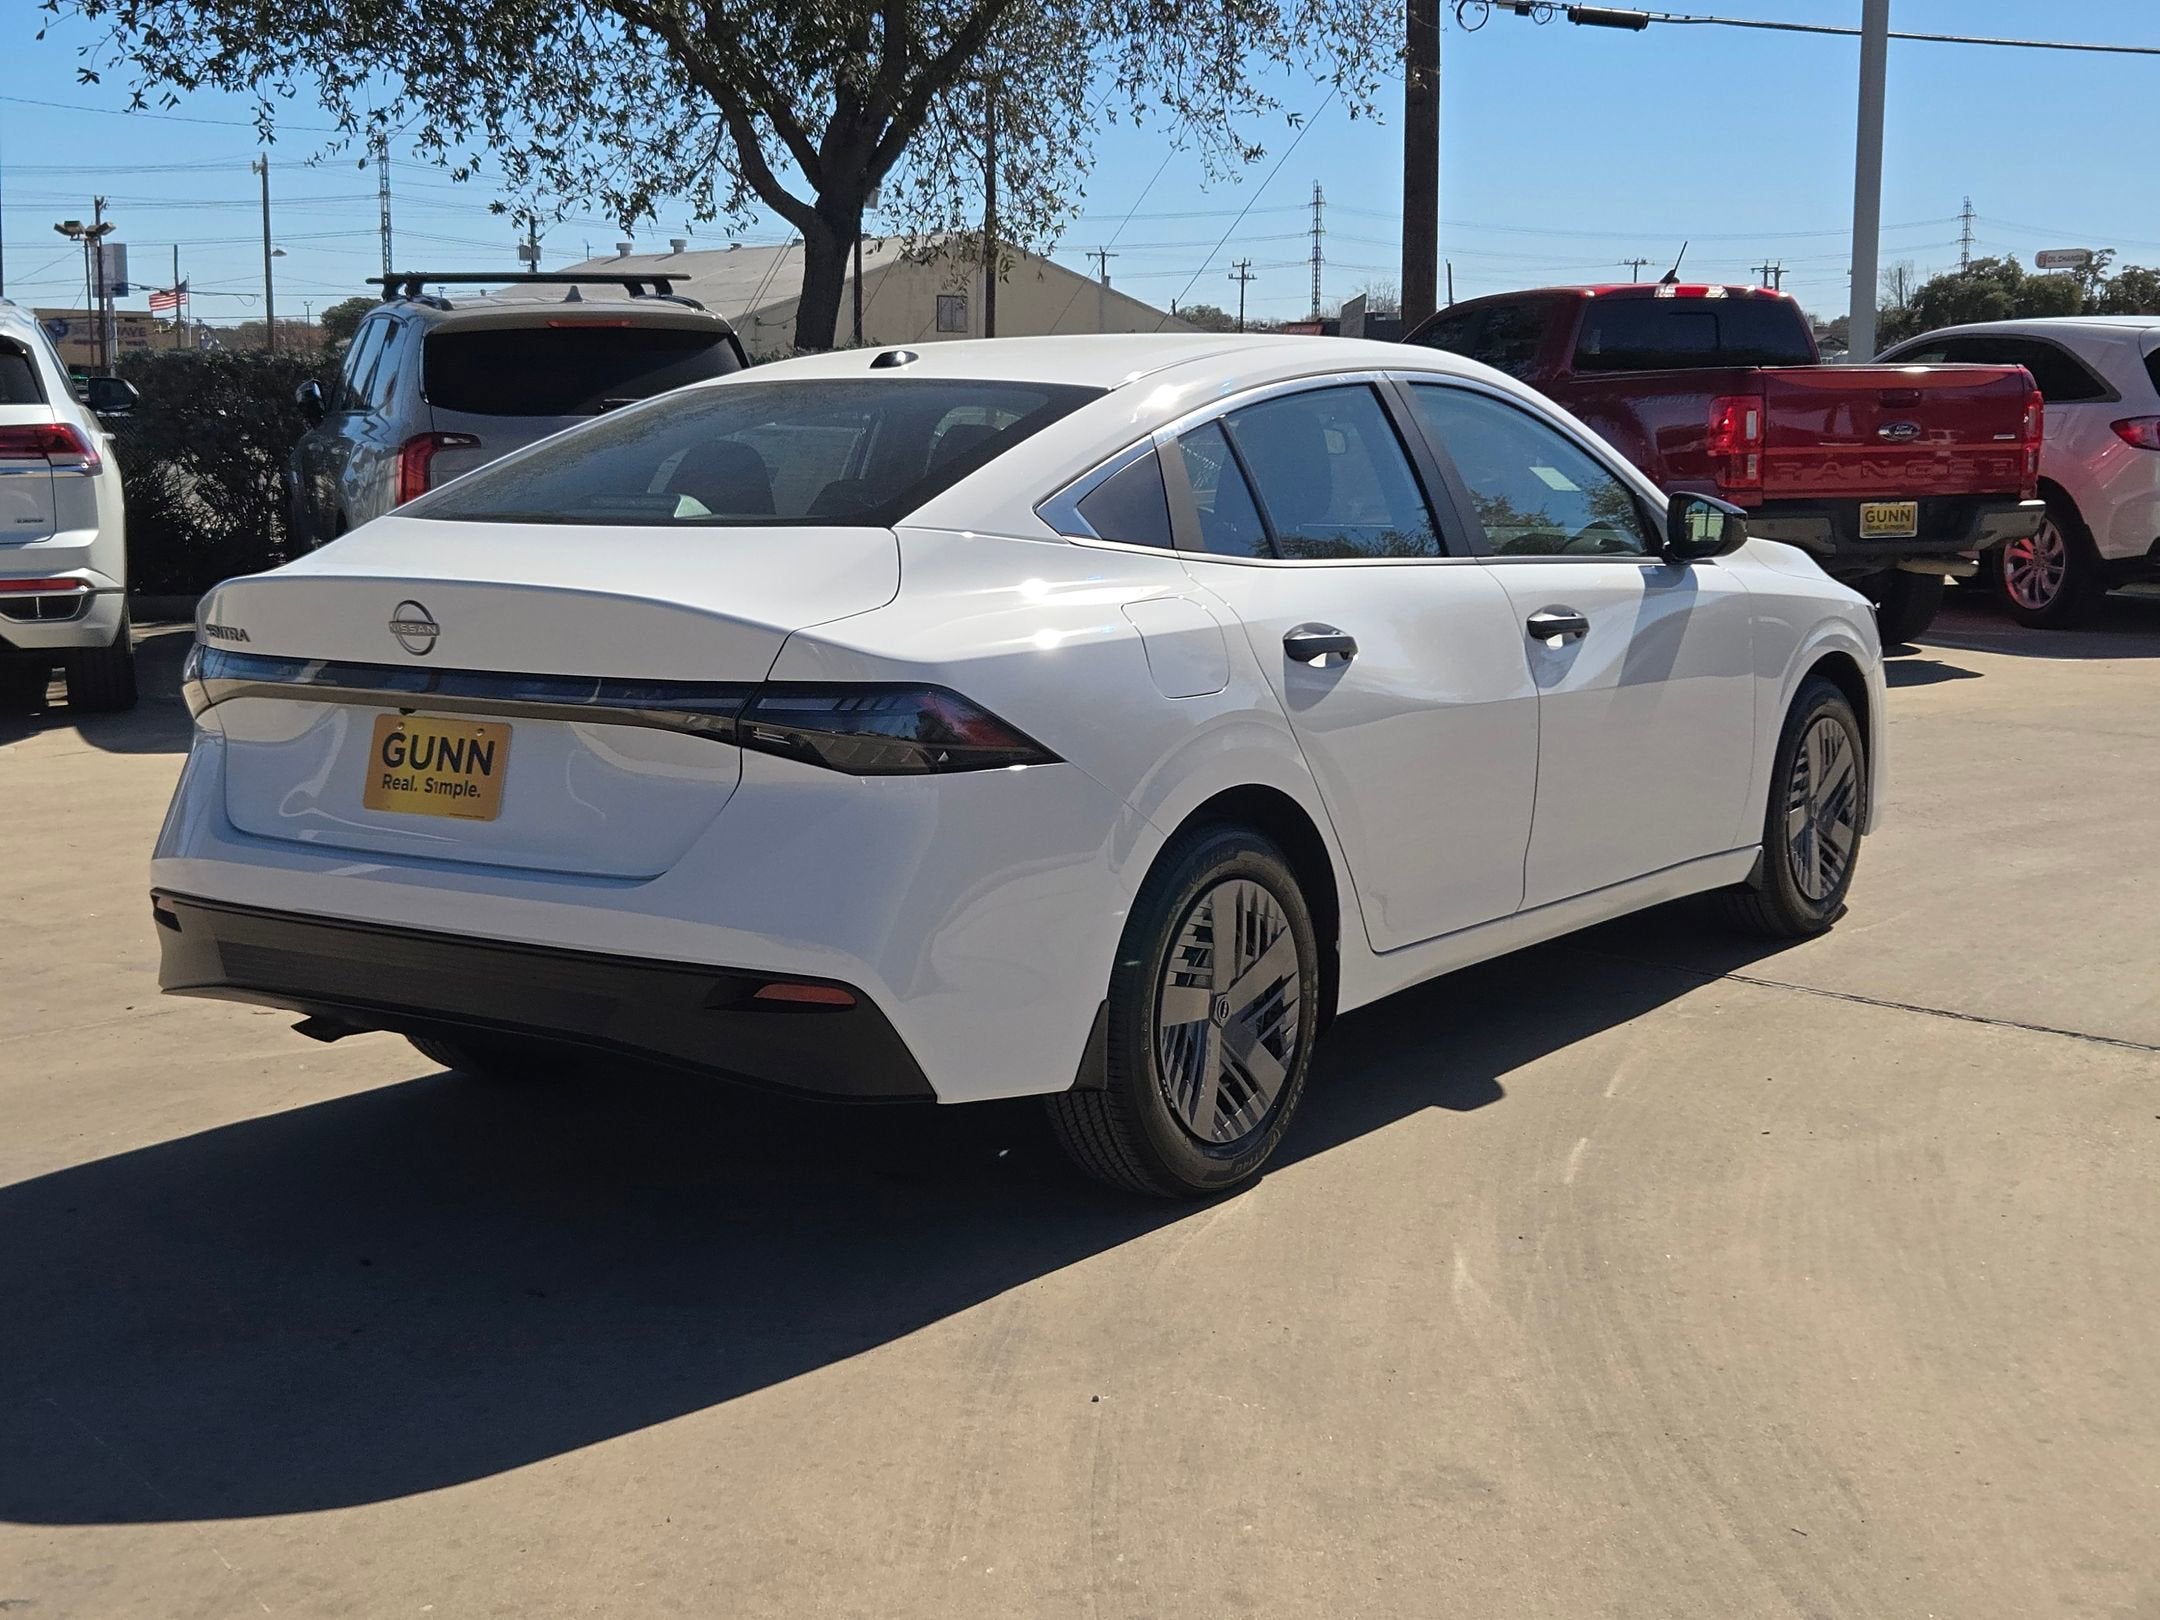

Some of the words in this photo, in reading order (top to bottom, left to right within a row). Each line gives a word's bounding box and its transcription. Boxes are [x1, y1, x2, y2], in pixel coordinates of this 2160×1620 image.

[1772, 457, 2016, 482] RANGER
[1865, 509, 1911, 523] GUNN
[389, 622, 438, 635] NISSAN
[382, 732, 496, 776] GUNN
[382, 773, 418, 792] Real.
